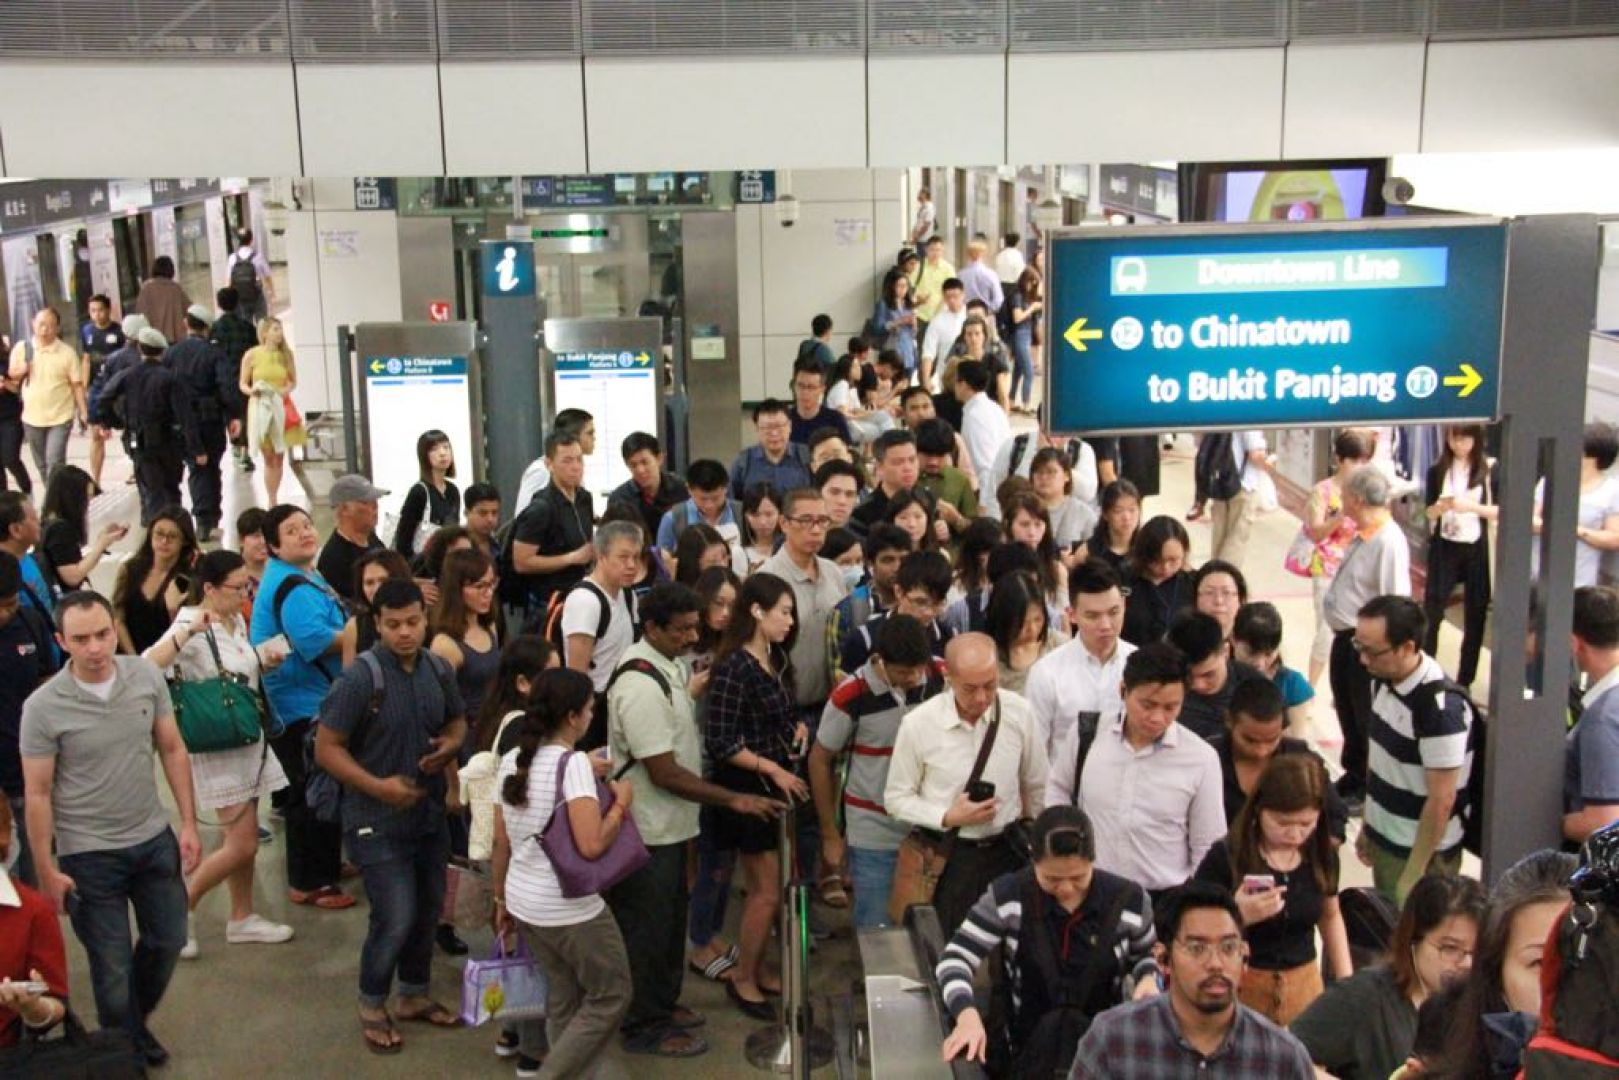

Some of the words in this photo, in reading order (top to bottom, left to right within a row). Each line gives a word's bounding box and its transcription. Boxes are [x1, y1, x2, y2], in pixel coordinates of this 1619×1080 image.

[1197, 259, 1336, 285] Downtown
[1343, 254, 1399, 281] Line
[1150, 320, 1184, 349] to
[1190, 314, 1350, 347] Chinatown
[1148, 374, 1181, 404] to
[1187, 367, 1268, 402] Bukit
[1274, 365, 1398, 404] Panjang
